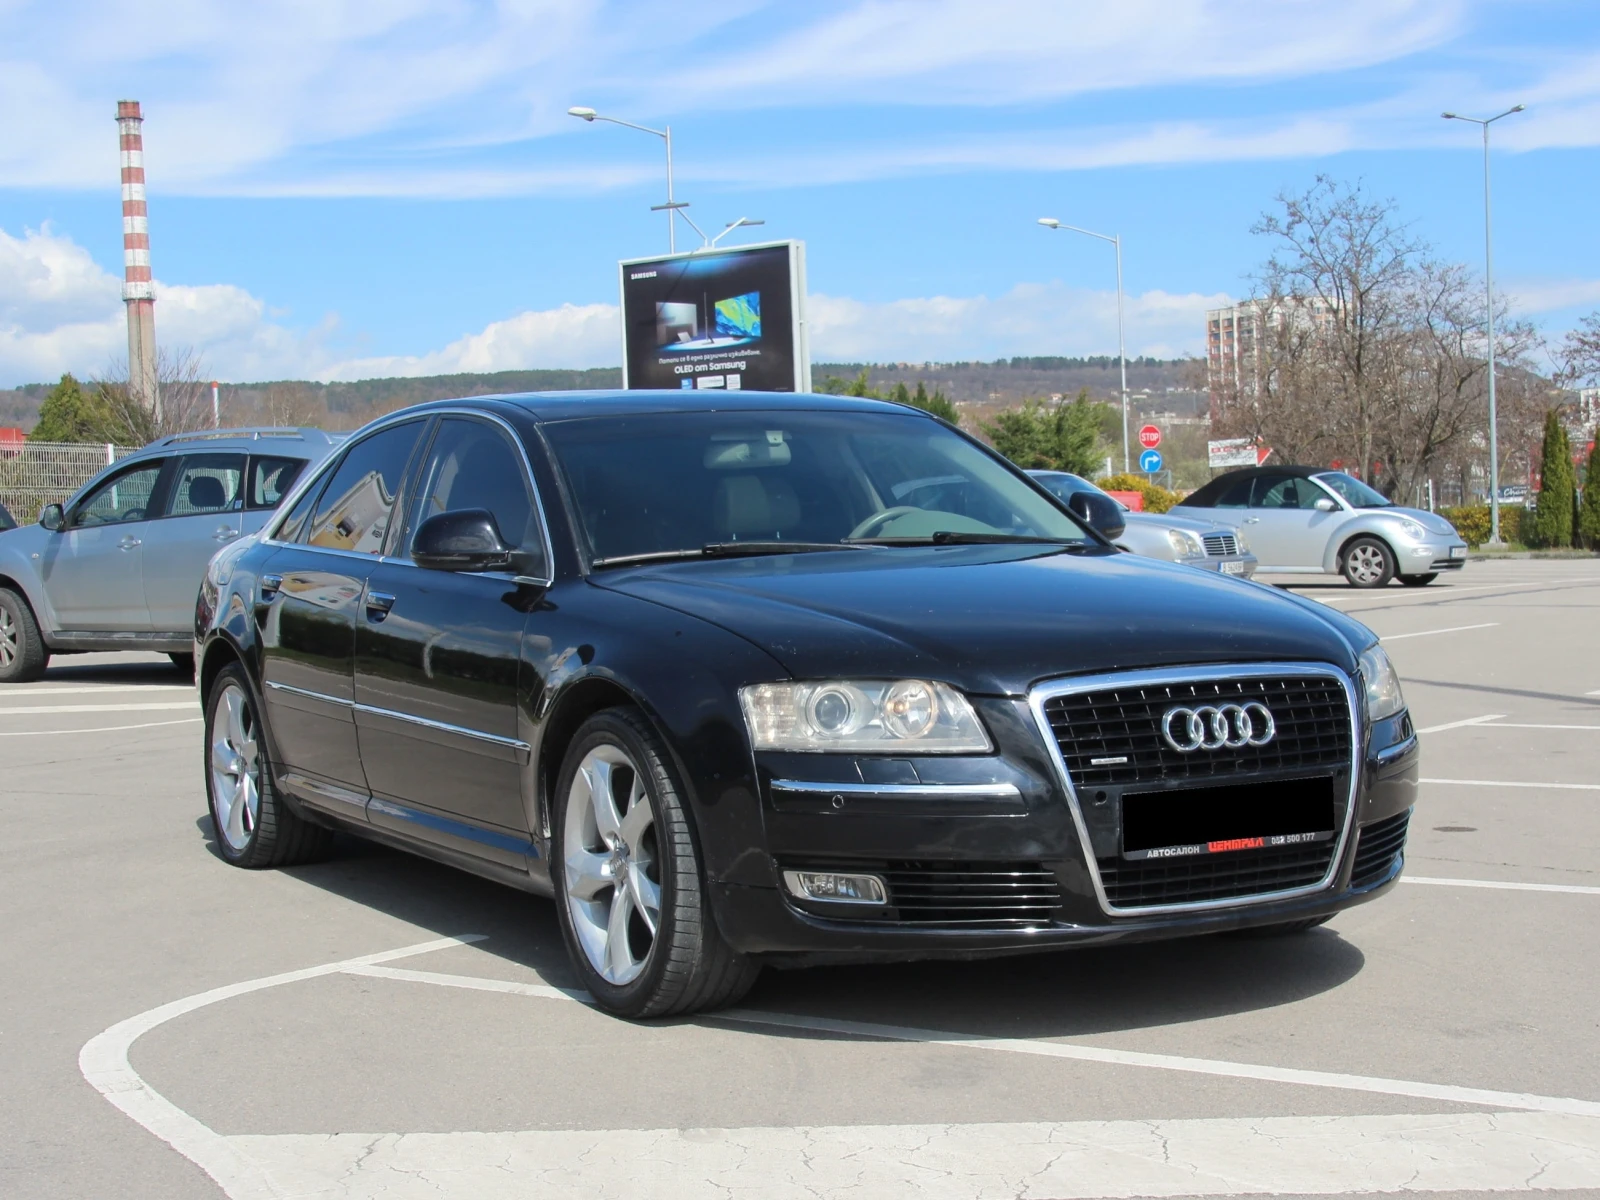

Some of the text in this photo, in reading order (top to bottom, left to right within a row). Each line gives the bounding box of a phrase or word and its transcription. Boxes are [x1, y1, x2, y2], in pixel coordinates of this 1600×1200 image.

[631, 271, 657, 280] SAMSUNG
[674, 365, 693, 374] OLED
[709, 361, 746, 371] Samsung
[1141, 432, 1159, 442] STOP
[1146, 846, 1200, 858] АВТОСАЛОН
[1208, 837, 1264, 852] ЦЕНТРАЛ
[1287, 834, 1301, 843] 500
[1302, 833, 1316, 842] 177
